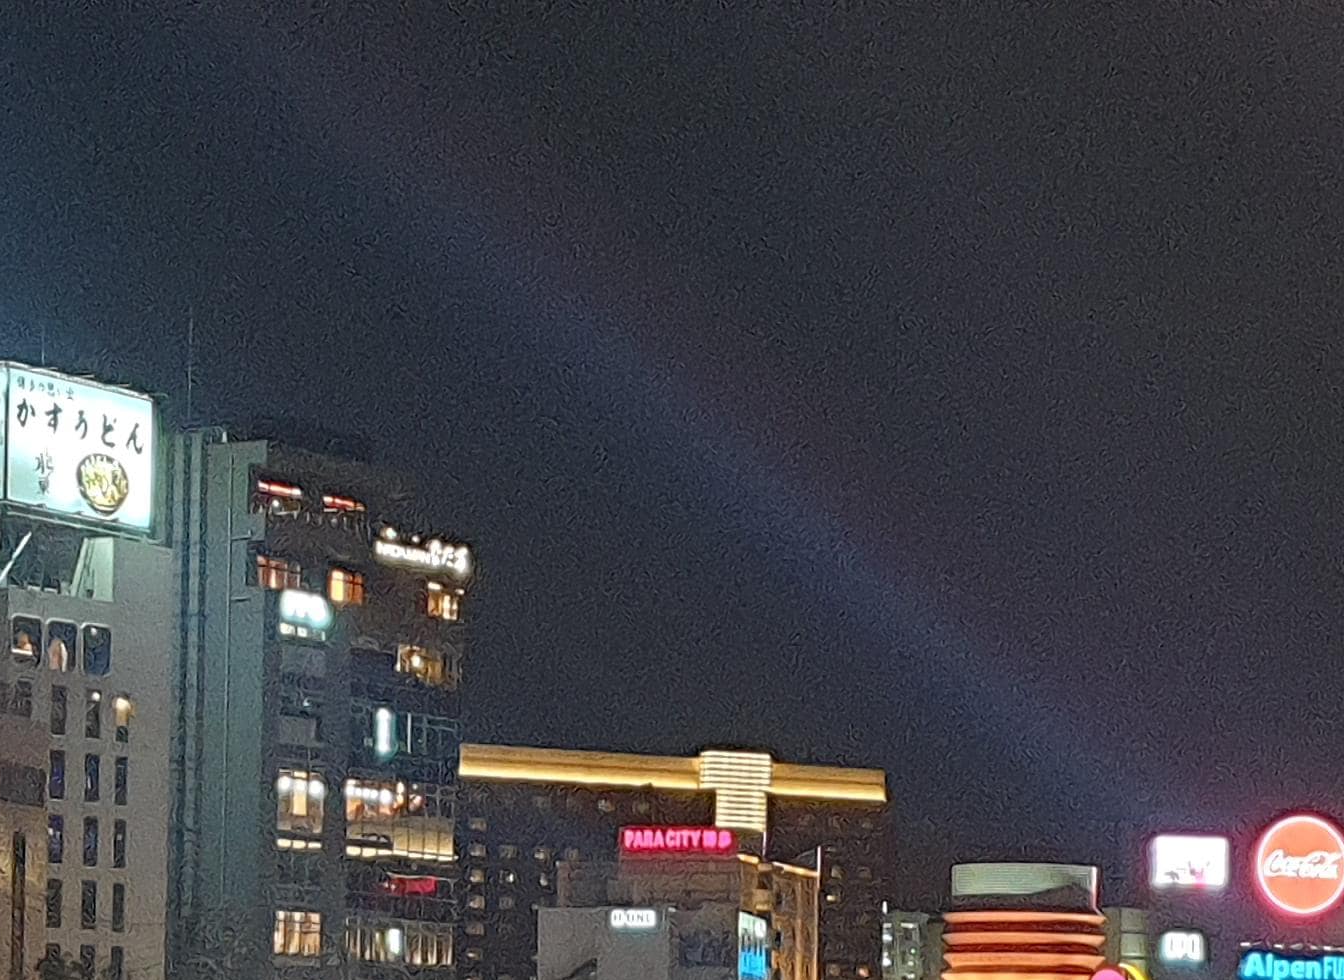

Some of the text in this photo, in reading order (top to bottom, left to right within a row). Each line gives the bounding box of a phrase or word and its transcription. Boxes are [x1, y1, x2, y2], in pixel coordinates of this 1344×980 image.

[16, 397, 144, 456] かすうどん
